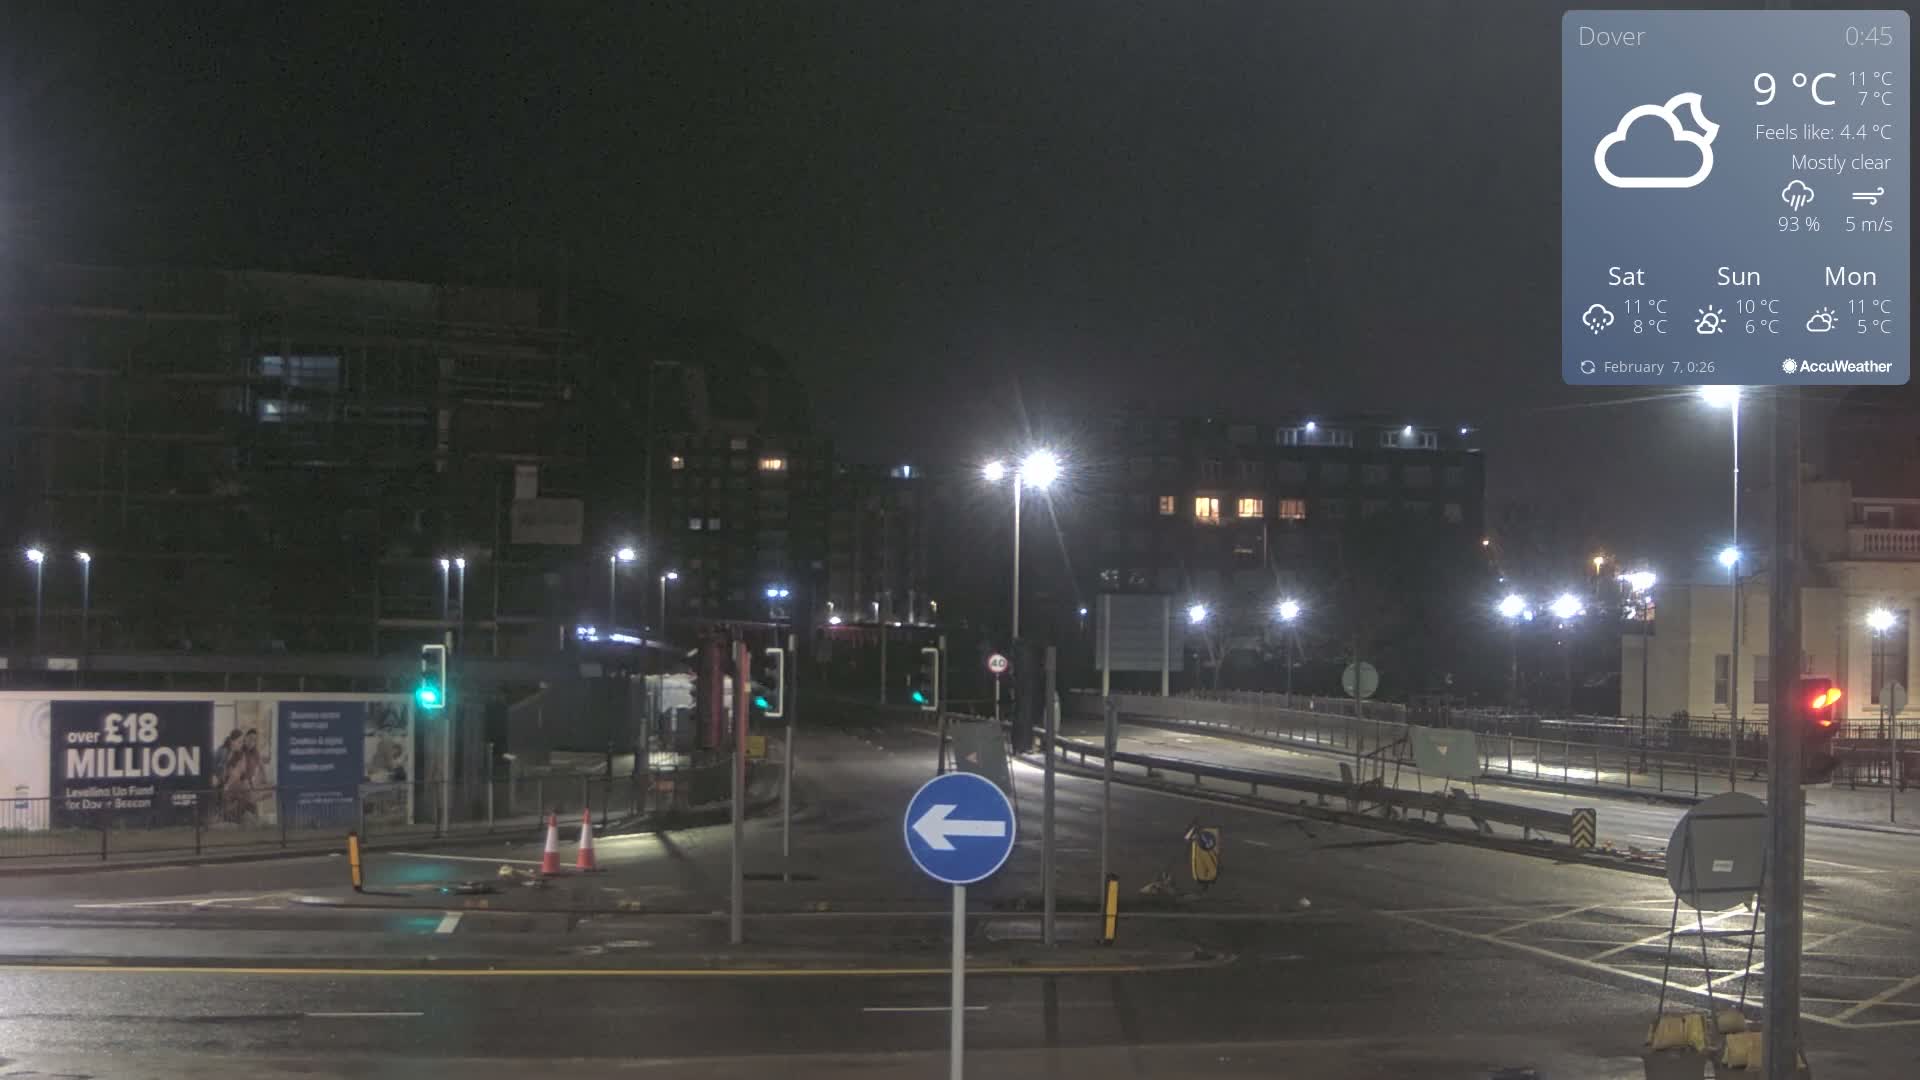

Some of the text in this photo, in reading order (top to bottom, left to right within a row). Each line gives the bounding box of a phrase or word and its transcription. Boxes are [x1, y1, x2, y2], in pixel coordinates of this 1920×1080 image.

[992, 658, 1005, 667] 40
[67, 712, 158, 743] over £18
[66, 746, 201, 778] MILLION
[82, 799, 112, 809] Dovr
